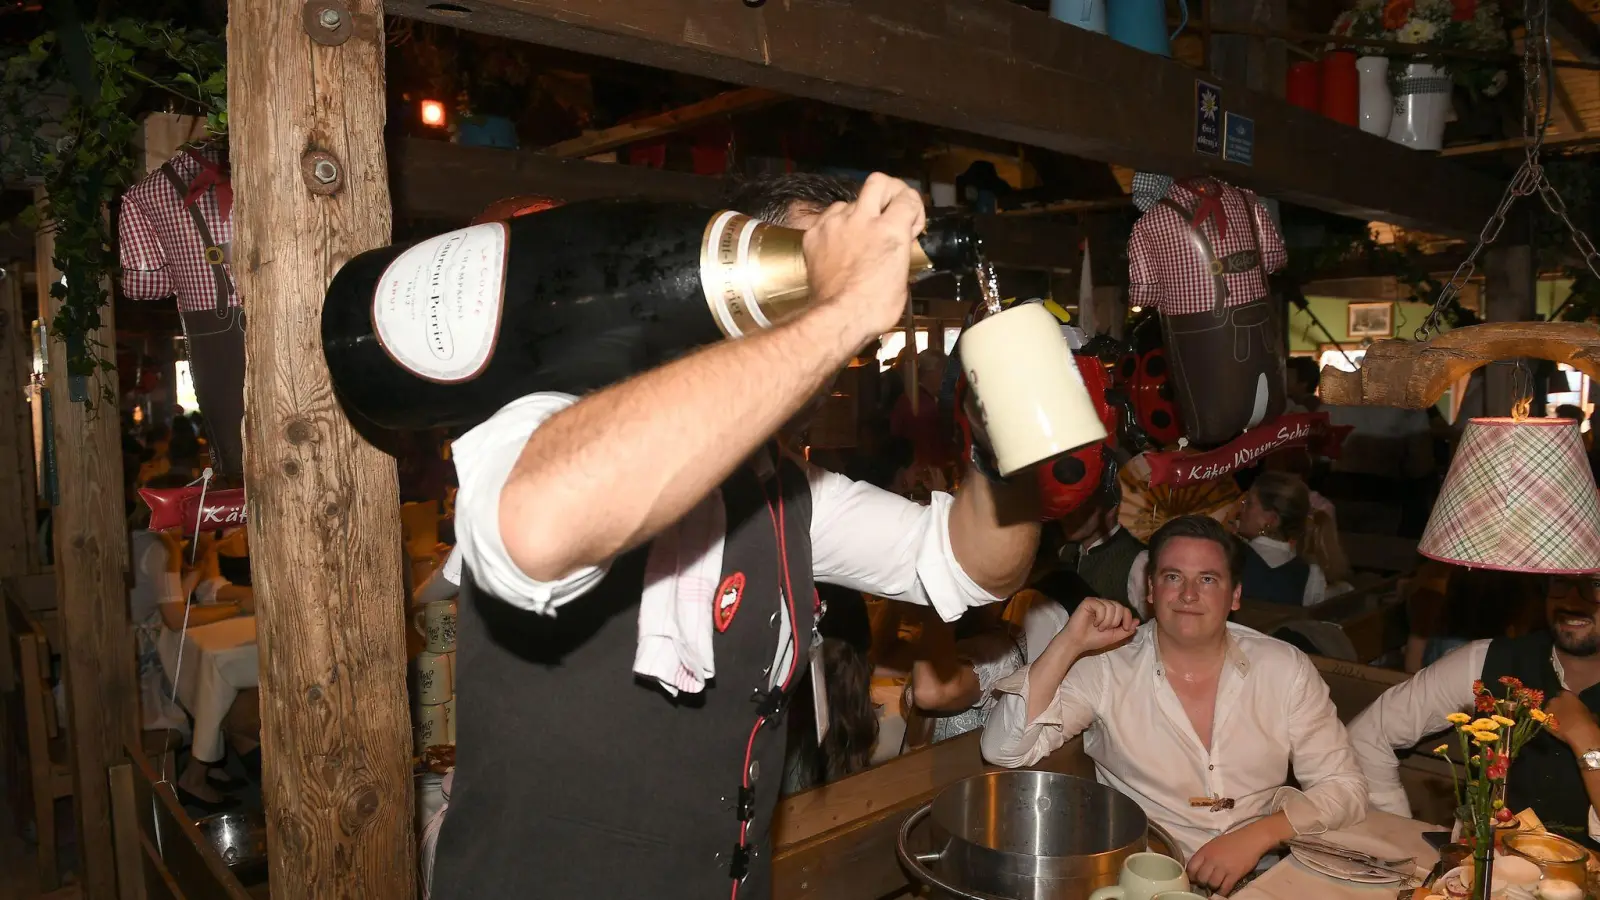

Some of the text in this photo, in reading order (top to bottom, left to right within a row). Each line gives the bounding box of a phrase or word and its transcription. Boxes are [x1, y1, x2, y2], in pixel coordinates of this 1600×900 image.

[389, 280, 399, 313] BRUT
[430, 236, 461, 354] Laurent-Perrier
[456, 248, 472, 321] CHAMPAGNE
